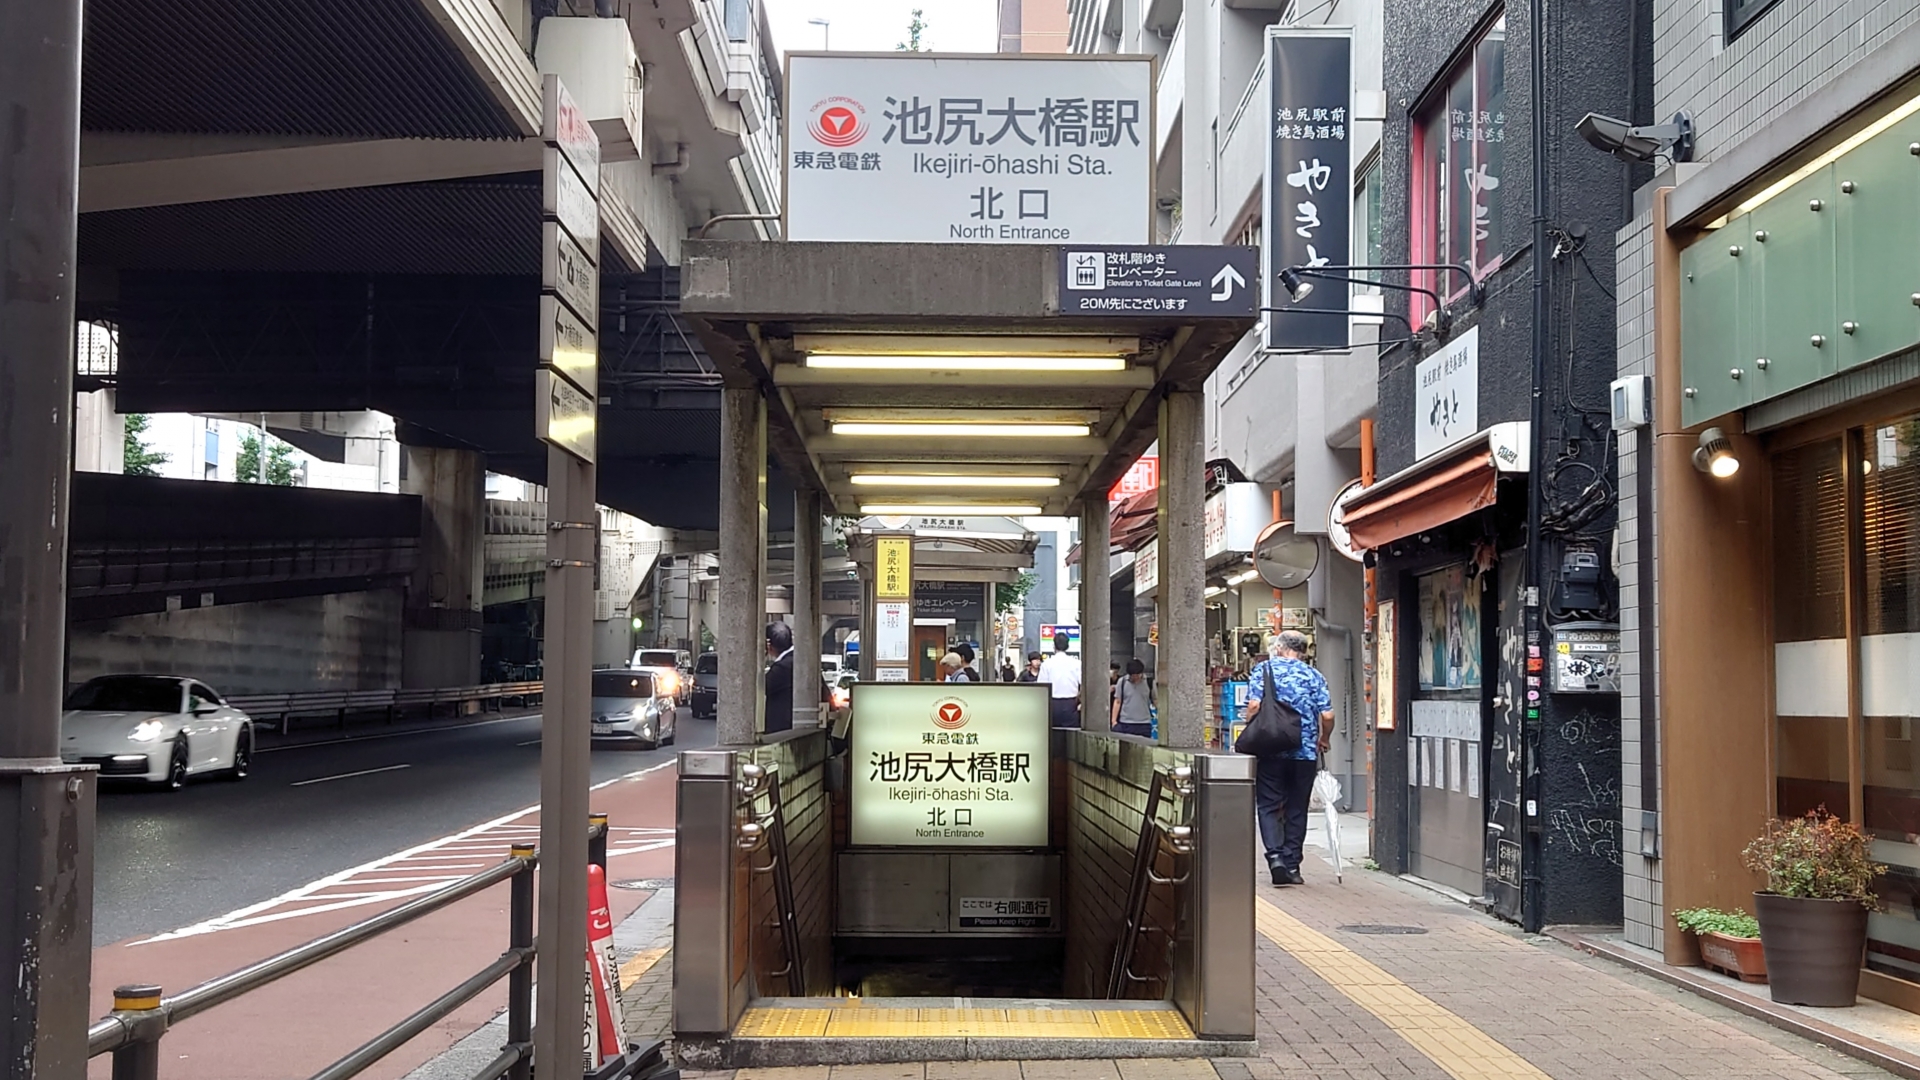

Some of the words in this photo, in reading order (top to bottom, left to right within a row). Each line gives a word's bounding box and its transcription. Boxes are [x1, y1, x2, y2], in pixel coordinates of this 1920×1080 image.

[809, 98, 827, 113] TOKYU
[827, 96, 866, 114] CORPORATION
[881, 96, 1140, 148] 池尻大橋駅
[1276, 107, 1346, 123] 池尻駅前
[1276, 124, 1346, 140] 焼き鳥酒場
[793, 150, 882, 171] 東急電鉄
[913, 152, 1059, 179] Ikejiri-ōhashi
[1066, 153, 1113, 176] Sta.
[970, 186, 1049, 220] 北口
[950, 224, 994, 239] North
[999, 224, 1070, 240] Entrance
[1106, 252, 1167, 266] 改札階ゆき
[1106, 267, 1177, 278] エレベーター
[1106, 279, 1134, 287] Elevator
[1143, 279, 1164, 287] Ticket
[1182, 280, 1202, 288] Level
[1080, 298, 1188, 311] 20M先にございます
[887, 548, 897, 591] 池尻大橋駅
[1502, 625, 1517, 774] やきと
[922, 732, 979, 745] 東急電鉄
[869, 751, 1031, 784] 池尻大橋駅
[889, 787, 981, 804] Ikejiri-ōhashi
[985, 787, 1014, 801] Sta.
[927, 806, 972, 827] 北口
[915, 828, 942, 838] North
[944, 828, 985, 838] Entrance
[962, 901, 993, 909] ここでは
[994, 901, 1049, 915] 右側通行
[998, 918, 1017, 926] Keep
[1018, 918, 1036, 926] Right
